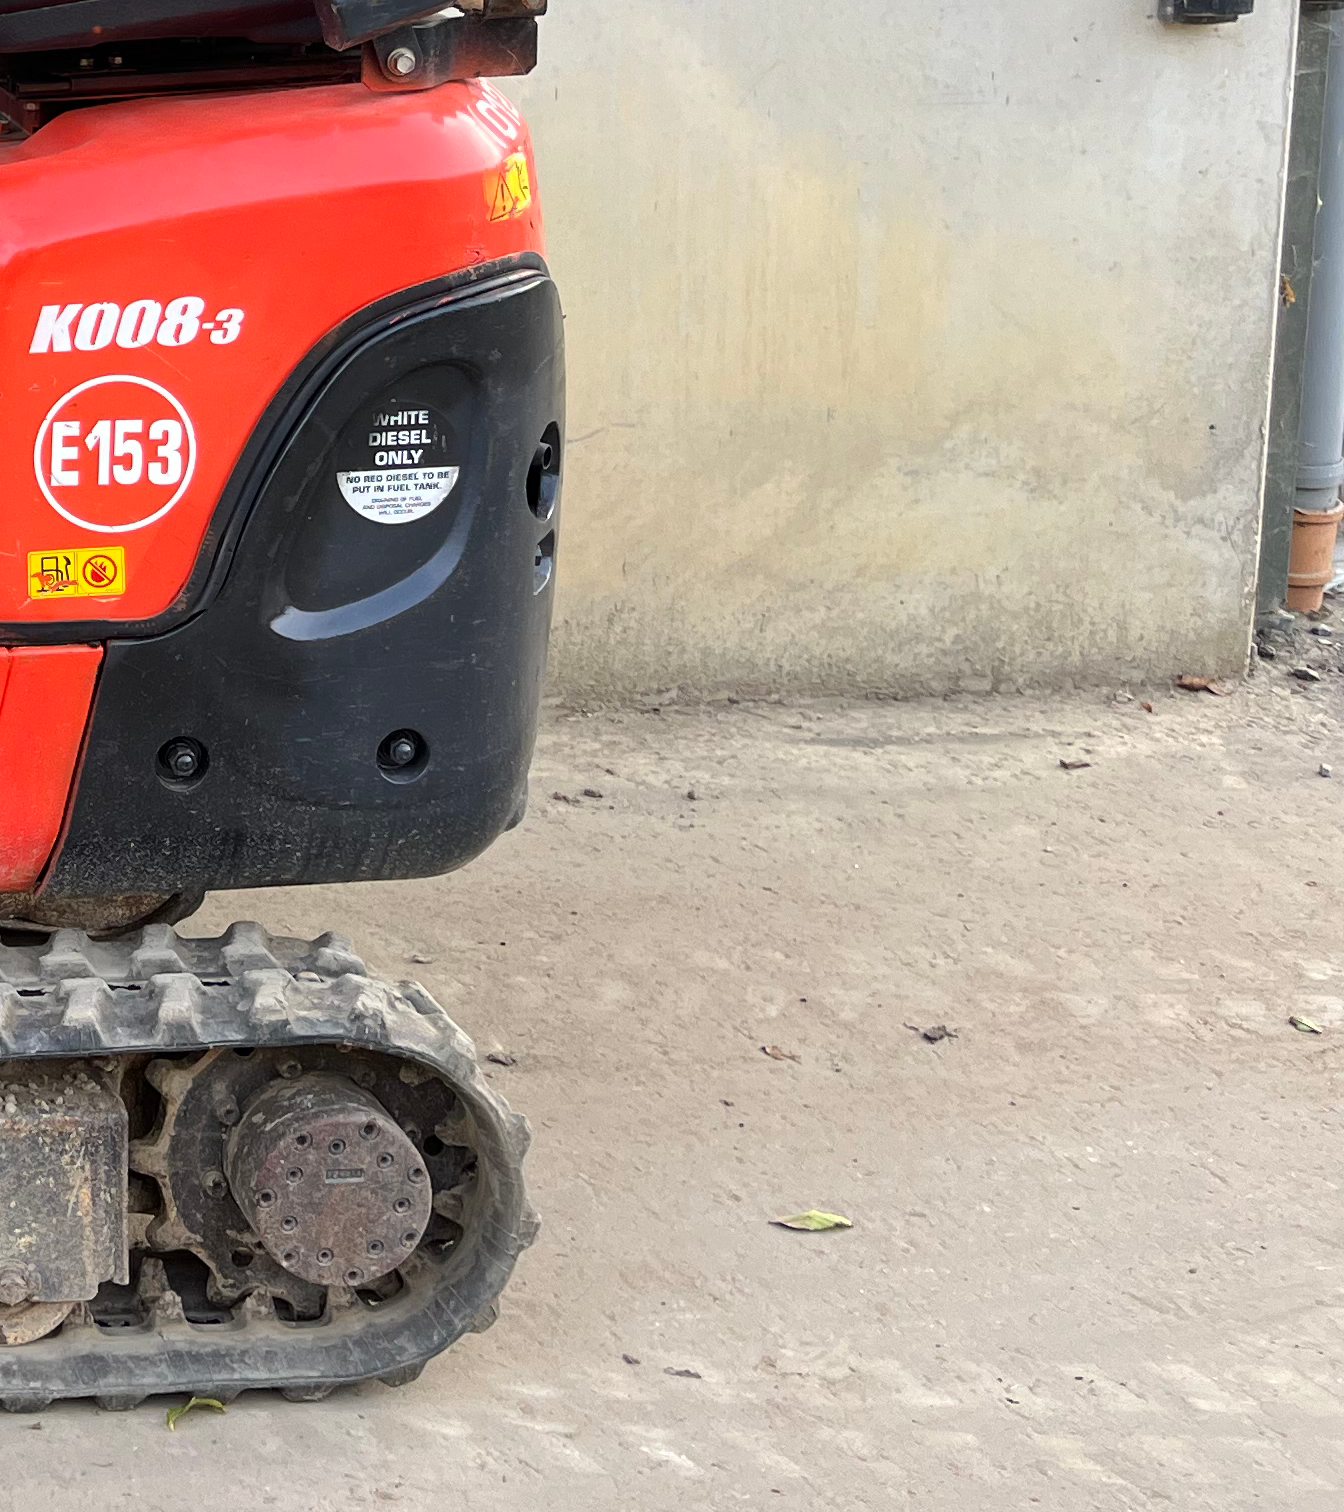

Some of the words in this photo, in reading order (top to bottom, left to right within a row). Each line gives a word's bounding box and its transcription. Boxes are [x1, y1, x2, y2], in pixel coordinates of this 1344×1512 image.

[28, 296, 245, 354] K008-3
[372, 410, 429, 426] WHITE
[368, 429, 432, 447] DIESEL
[50, 419, 183, 487] E153
[375, 449, 423, 466] ONLY
[363, 475, 383, 483] RED
[386, 471, 419, 482] DIESEL
[422, 472, 434, 480] TO
[437, 471, 450, 479] BE
[352, 485, 371, 494] PUT
[373, 484, 384, 493] IN
[387, 483, 411, 492] FUEL
